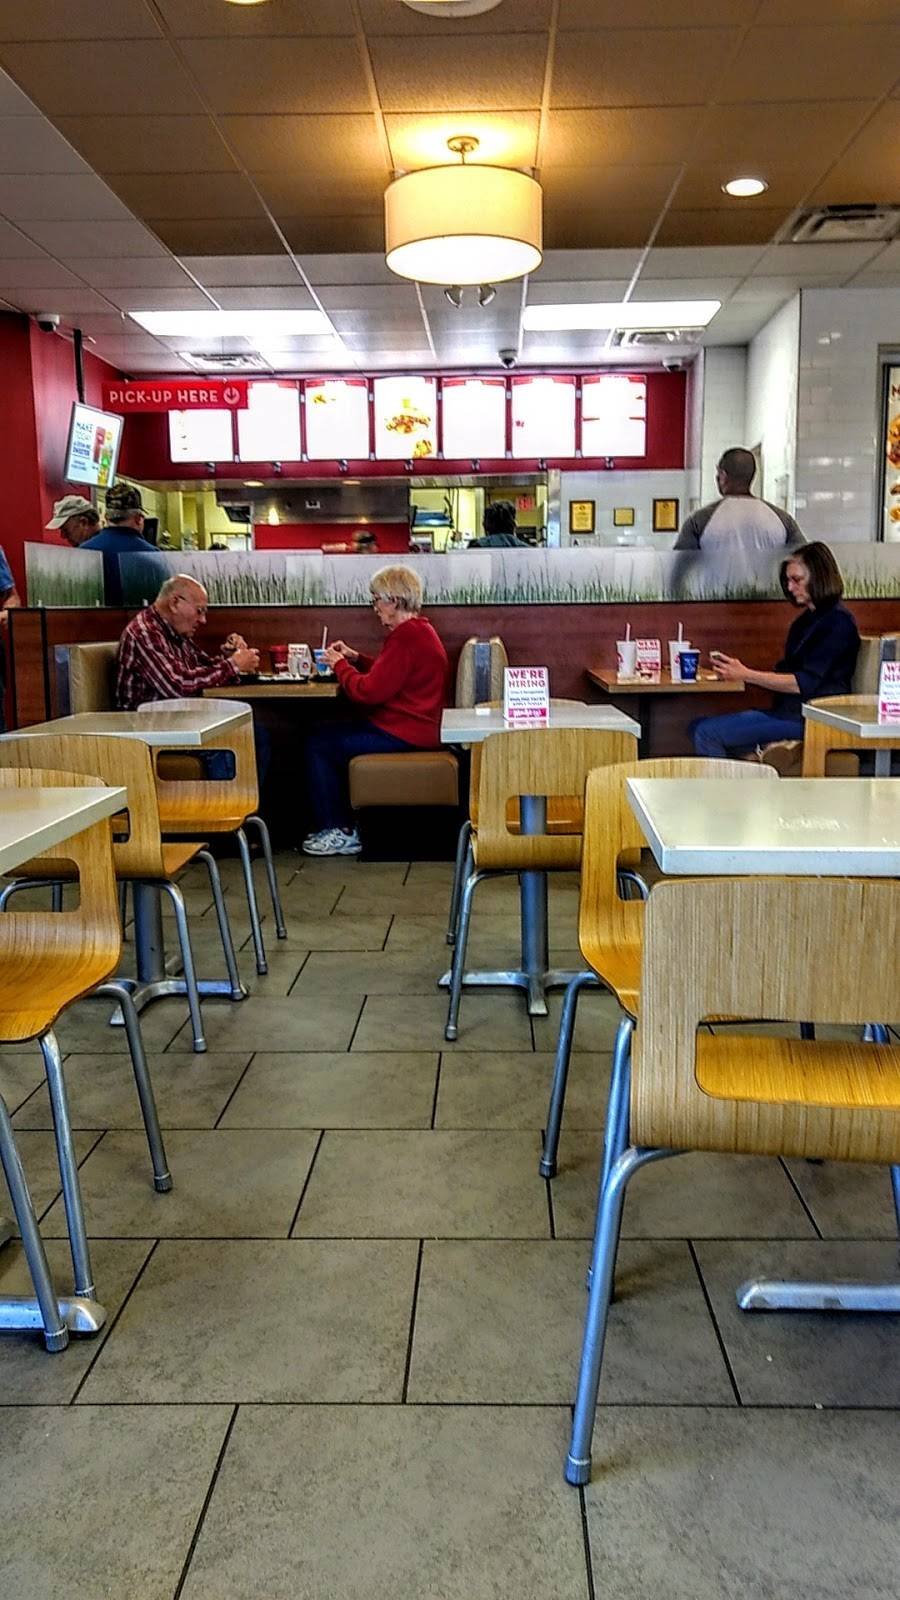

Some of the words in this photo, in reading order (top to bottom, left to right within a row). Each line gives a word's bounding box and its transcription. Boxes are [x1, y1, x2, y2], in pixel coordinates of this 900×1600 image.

[109, 390, 172, 403] PICK-UP
[177, 389, 218, 403] HERE
[508, 670, 545, 679] WE'RE
[508, 680, 546, 688] HIRING
